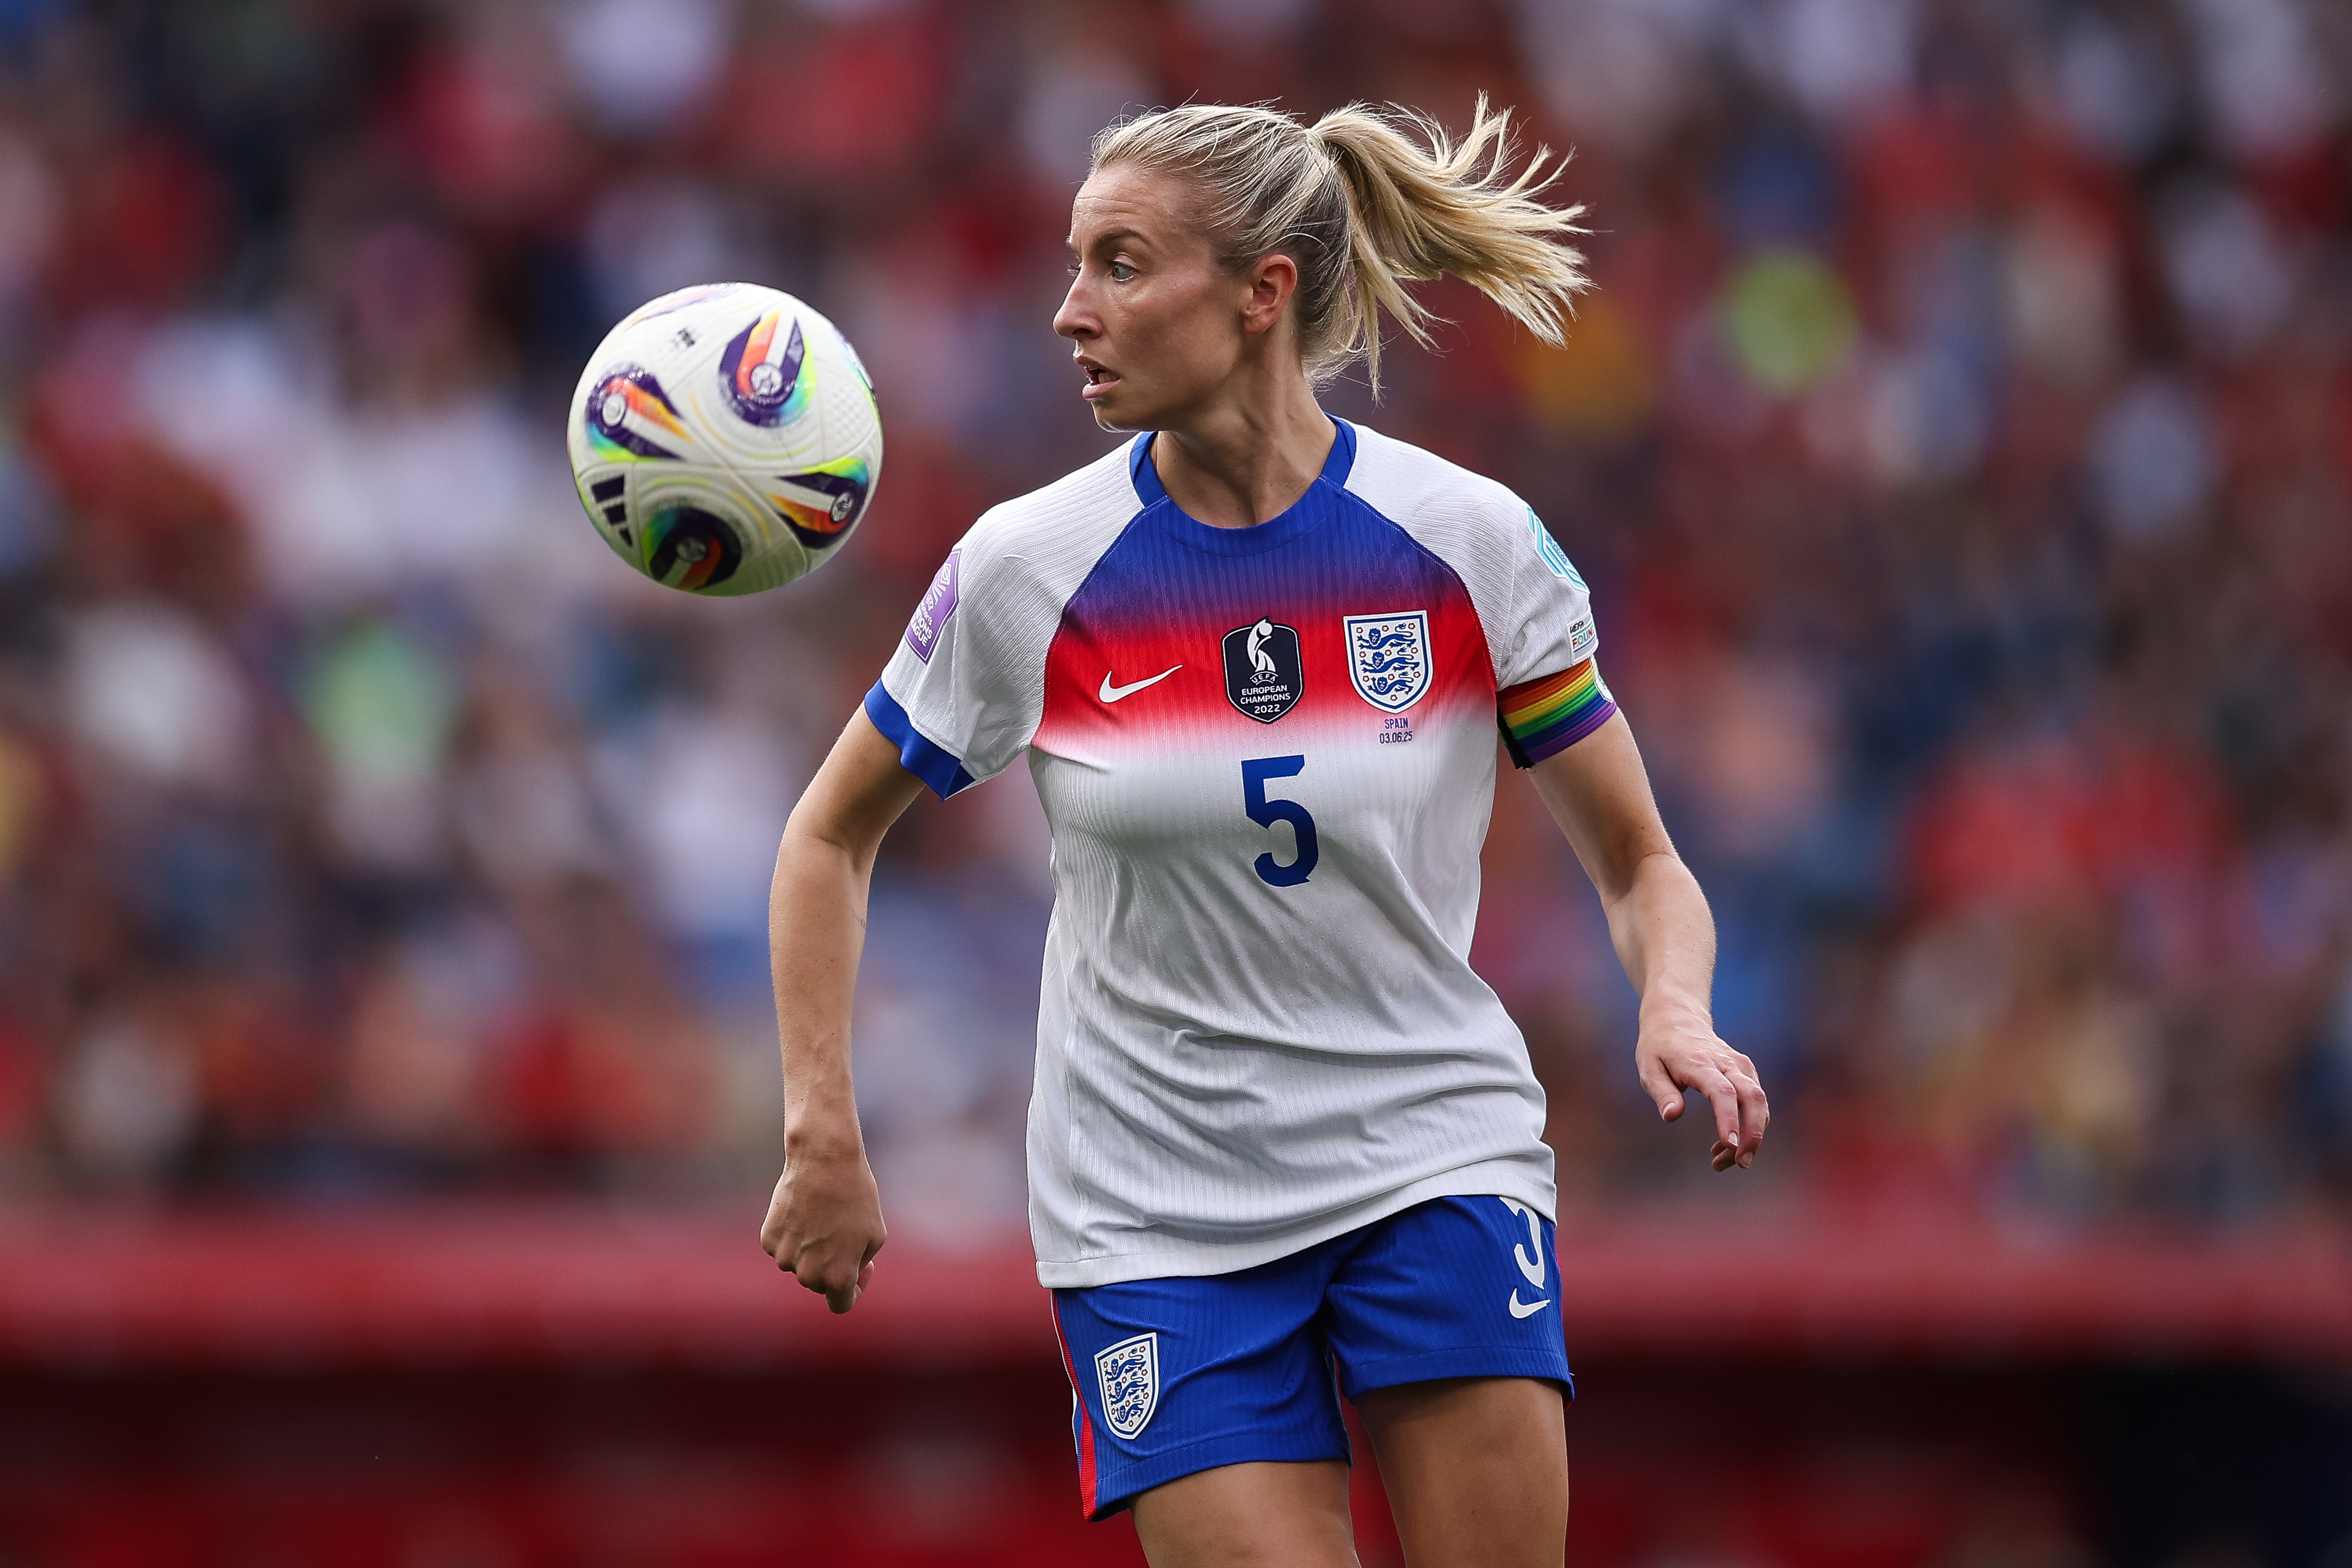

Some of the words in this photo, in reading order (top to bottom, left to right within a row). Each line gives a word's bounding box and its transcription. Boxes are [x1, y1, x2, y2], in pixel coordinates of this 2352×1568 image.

[1570, 621, 1584, 634] UEFA
[1251, 674, 1276, 683] UEFA
[1241, 685, 1287, 695] EUROPEAN
[1240, 693, 1291, 705] CHAMPIONS
[1254, 704, 1280, 714] 2022
[1384, 718, 1408, 729] SPAIN
[1380, 731, 1413, 744] 03.06.25
[1241, 754, 1319, 887] 5
